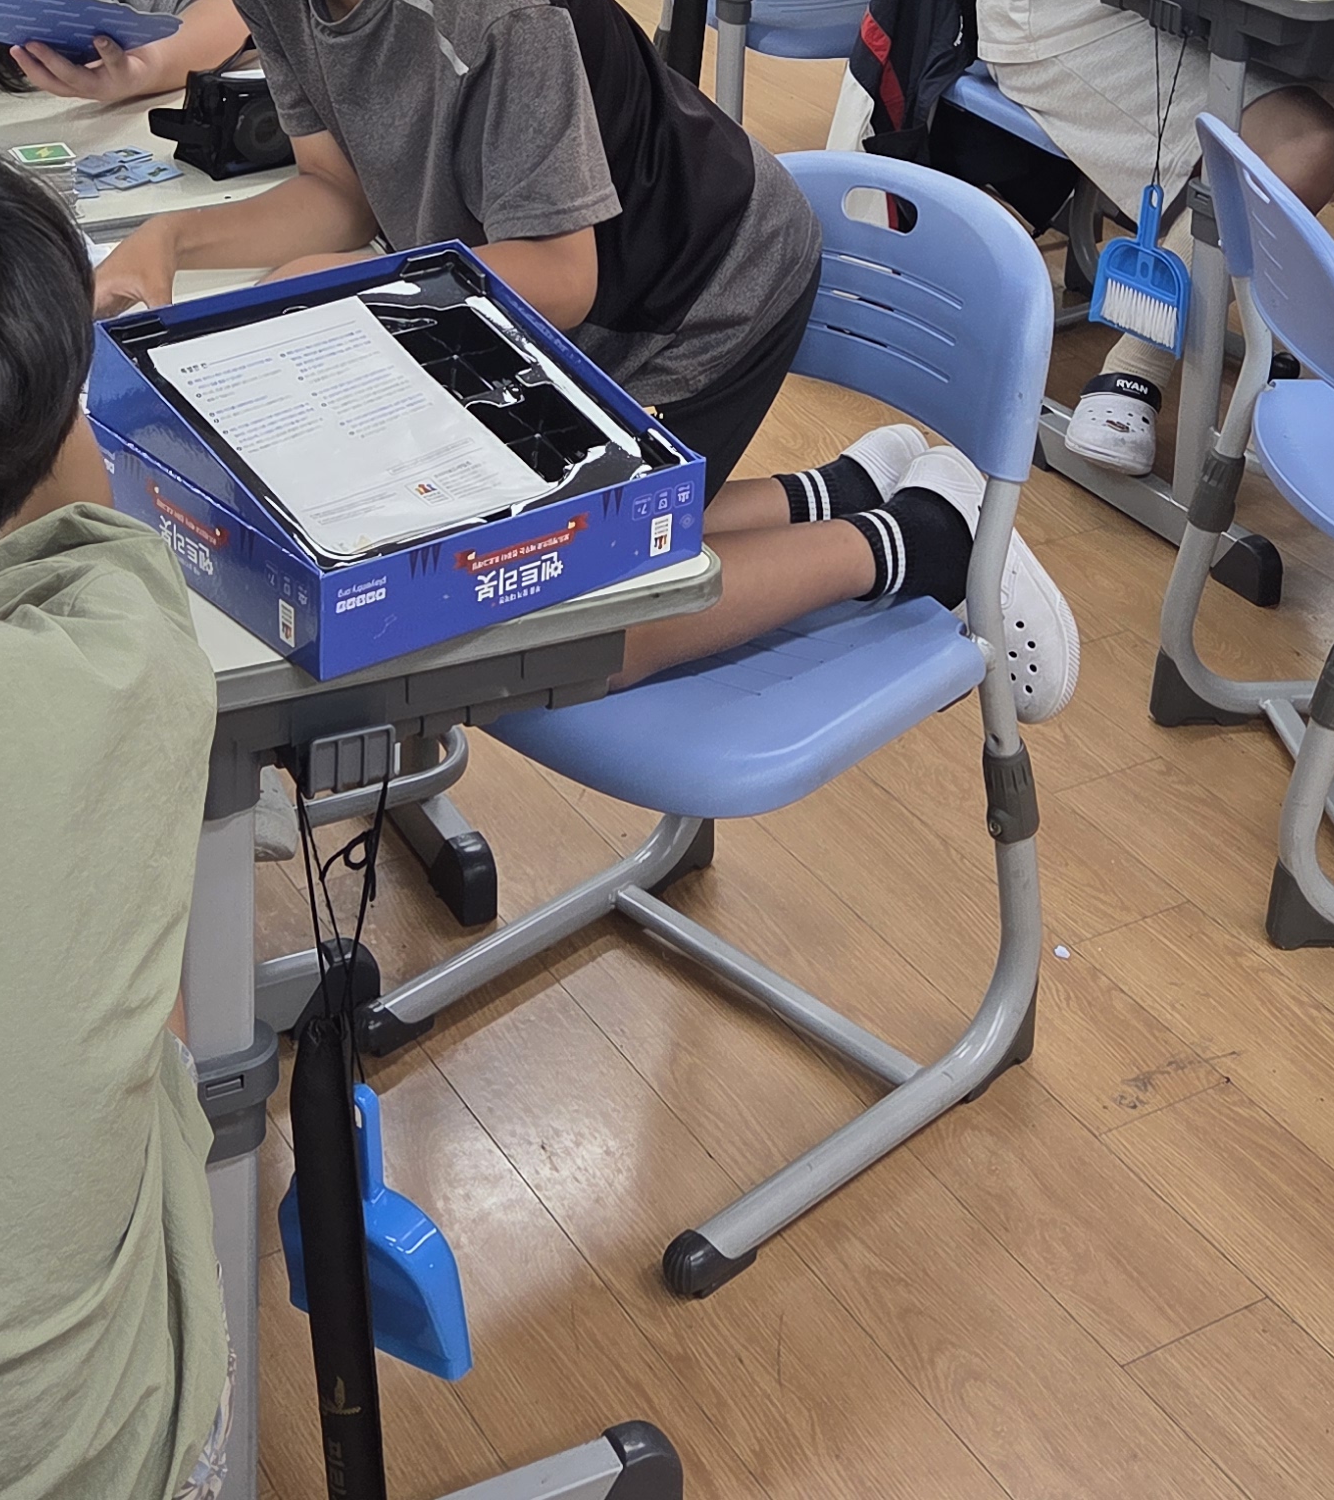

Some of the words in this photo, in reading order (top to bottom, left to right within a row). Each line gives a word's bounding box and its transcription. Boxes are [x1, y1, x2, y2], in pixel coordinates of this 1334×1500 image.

[1116, 379, 1148, 395] RYAN
[158, 515, 214, 576] 엔트리봇
[337, 575, 387, 598] playentry.org
[474, 551, 564, 602] 엔트리봇
